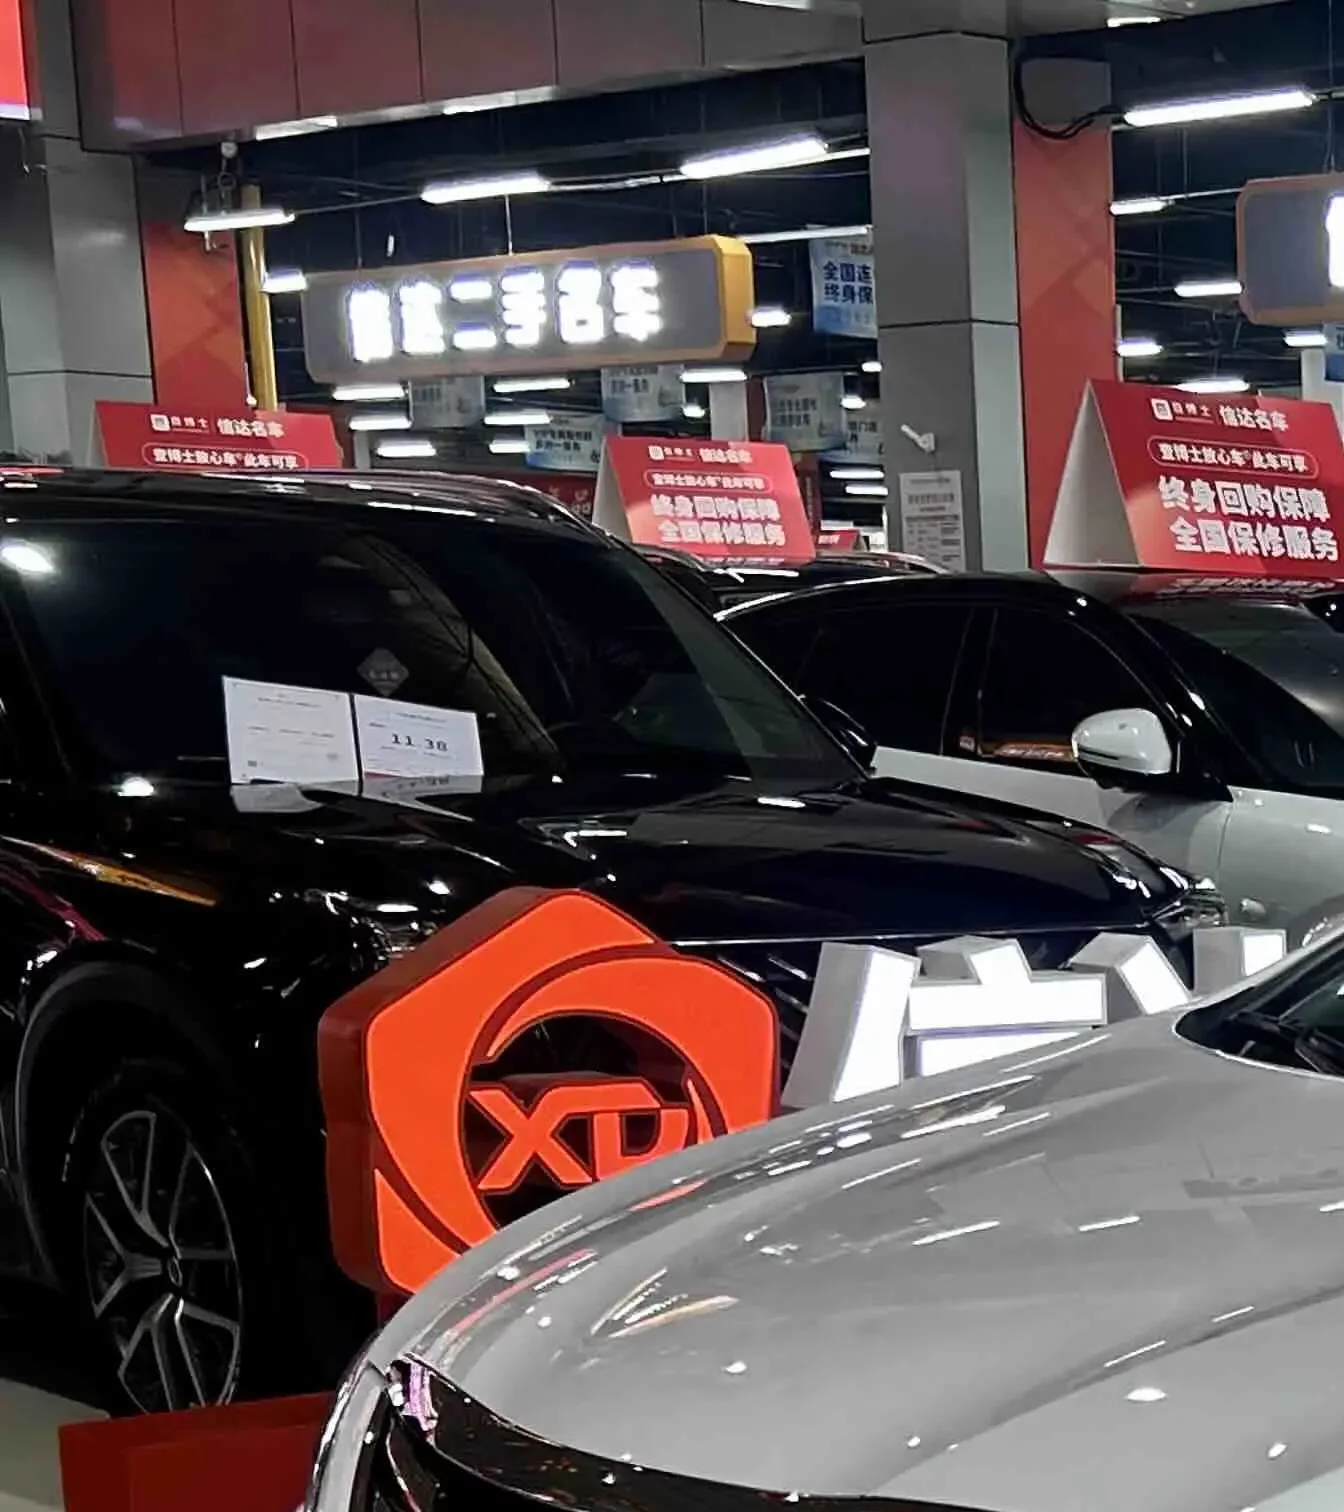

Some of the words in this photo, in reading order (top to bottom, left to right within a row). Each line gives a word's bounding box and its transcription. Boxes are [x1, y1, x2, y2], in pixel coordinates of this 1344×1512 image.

[823, 261, 872, 284] 全国连
[217, 418, 286, 438] 信达名车
[1219, 405, 1289, 432] 信达名车
[1158, 475, 1332, 523] 终身回购保障
[1168, 515, 1340, 561] 全国保修服务
